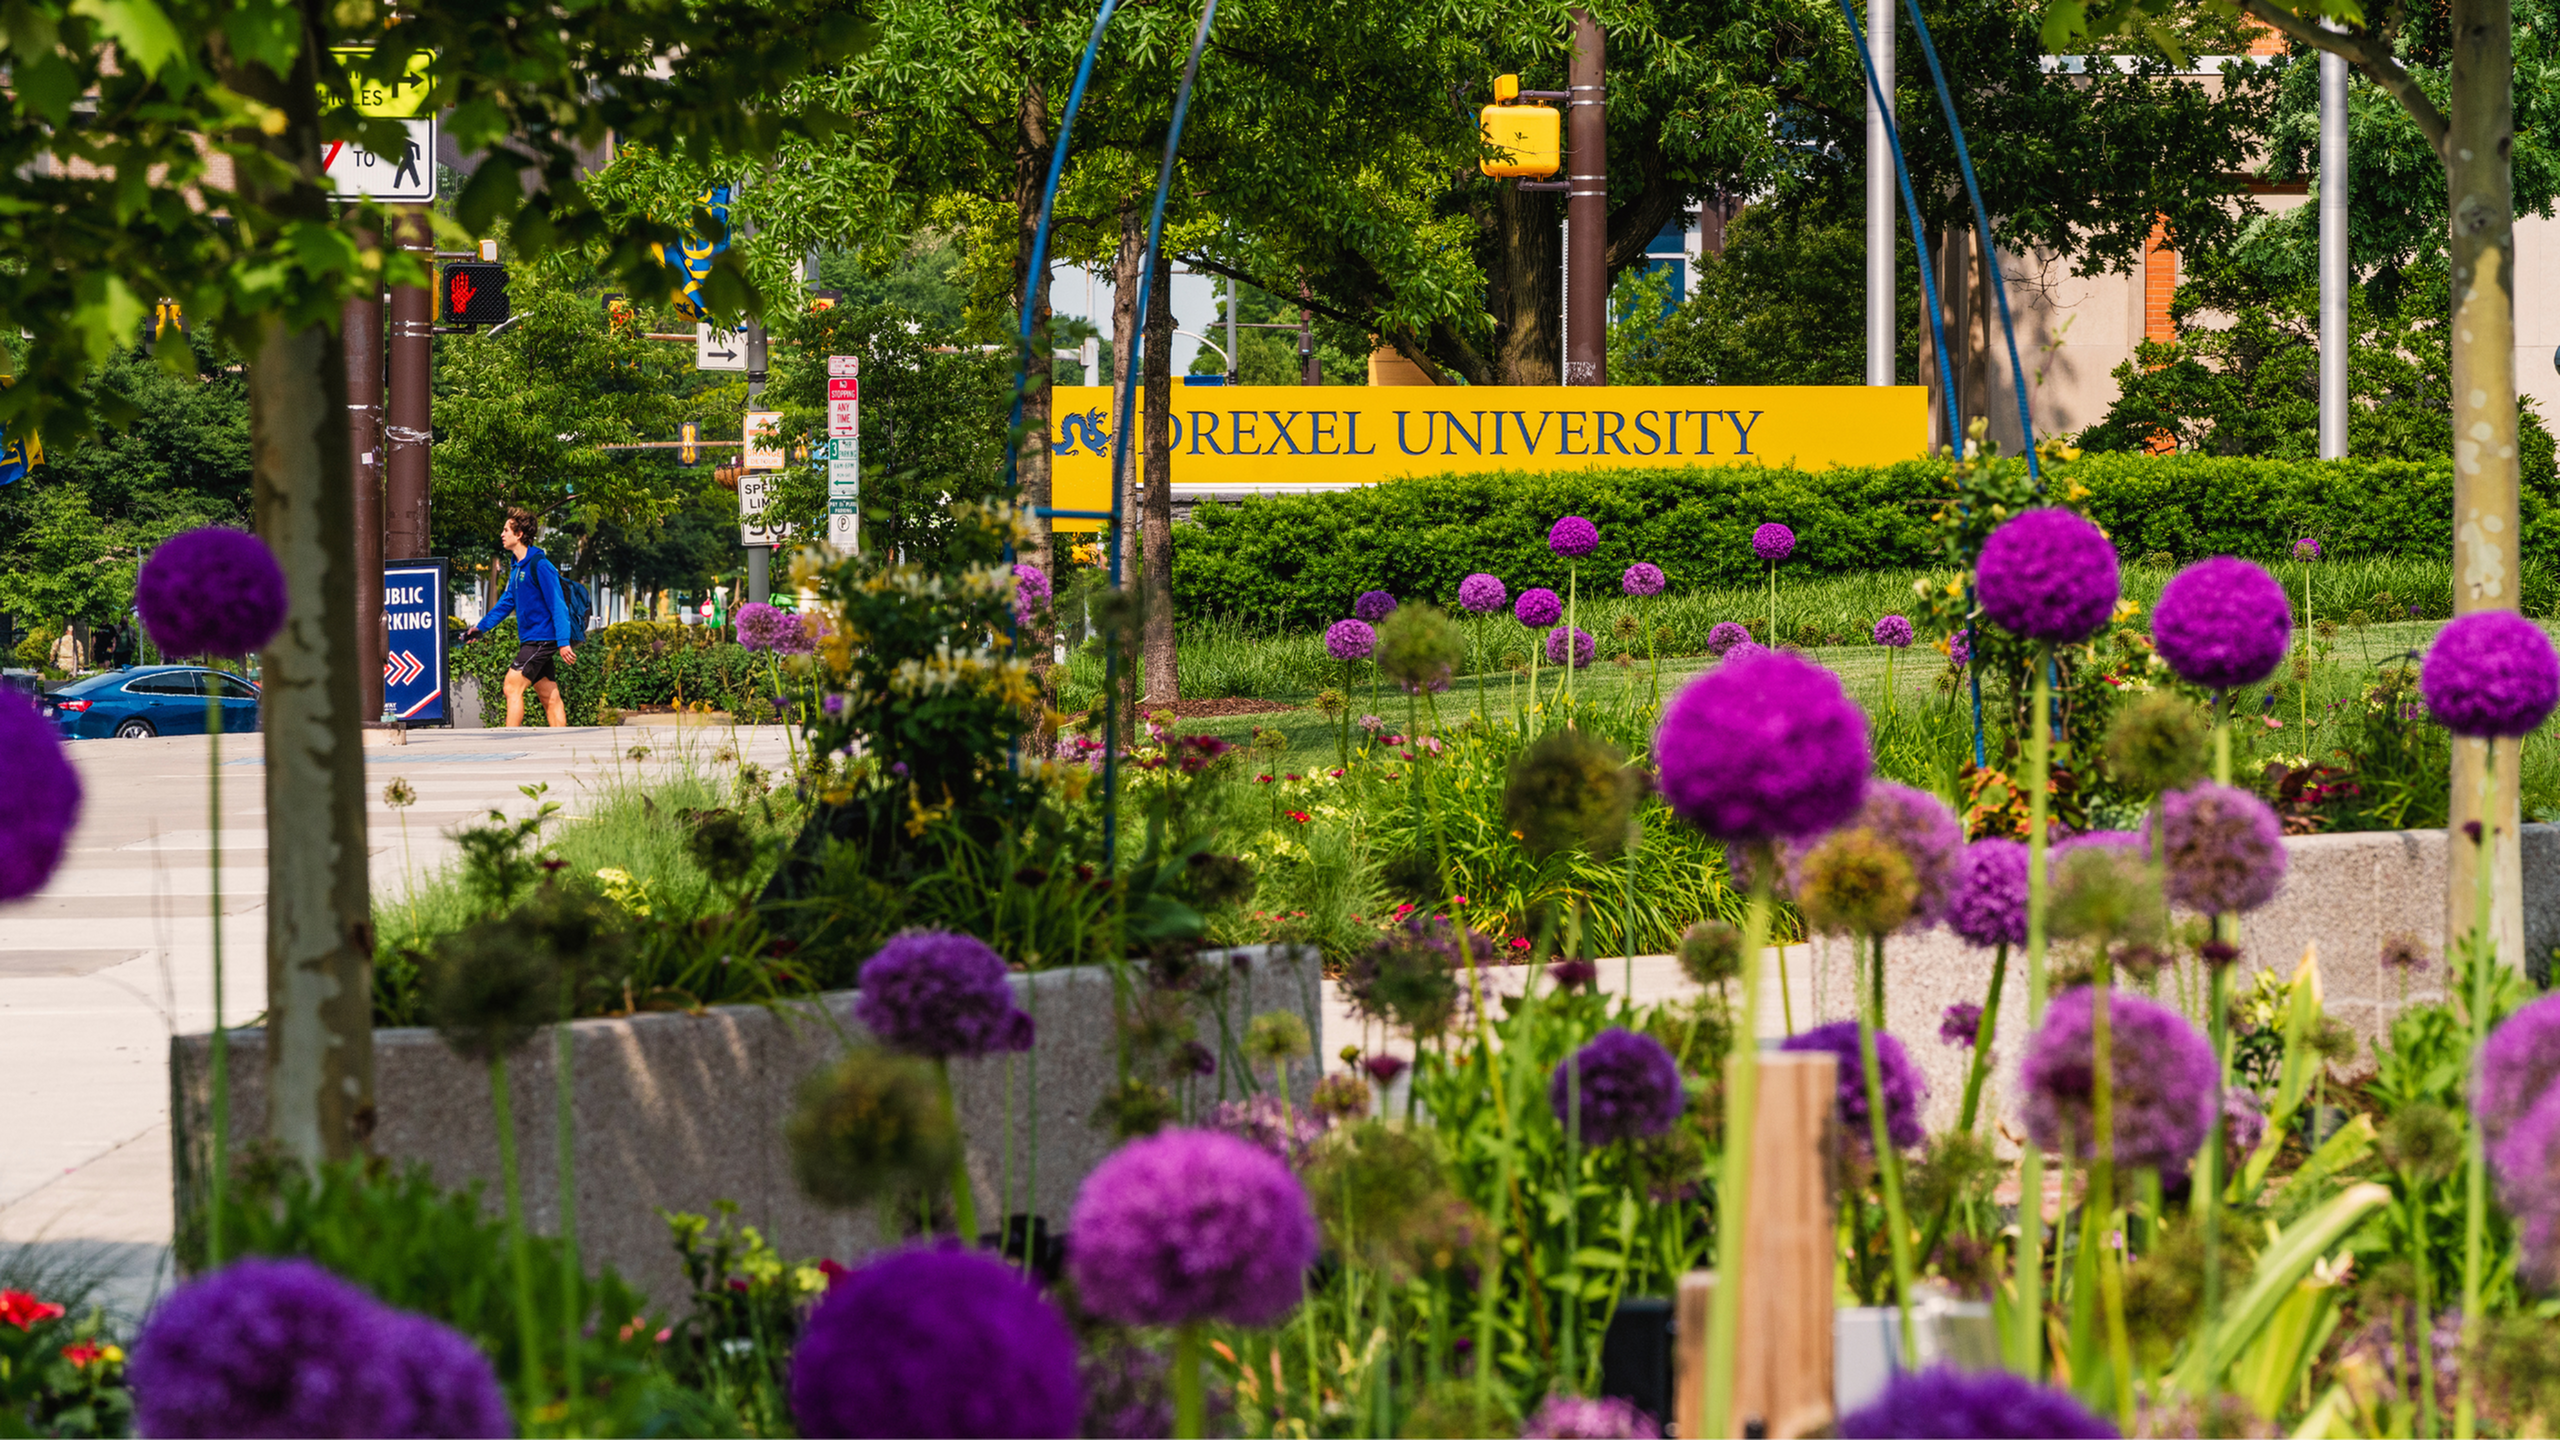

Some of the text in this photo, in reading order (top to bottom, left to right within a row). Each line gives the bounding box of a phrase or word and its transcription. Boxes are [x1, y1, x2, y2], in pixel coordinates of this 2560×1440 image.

[353, 151, 375, 167] TO
[707, 330, 738, 343] WAY
[831, 390, 856, 399] STOPPING
[837, 403, 851, 412] ANY
[837, 414, 851, 424] TIME
[1392, 409, 1764, 456] UNIVERSITY
[746, 449, 782, 458] ORANGE
[832, 442, 838, 457] 3
[744, 484, 775, 495] SPE
[749, 498, 772, 509] LIM
[384, 586, 424, 605] UBLIC
[387, 611, 432, 630] RKING
